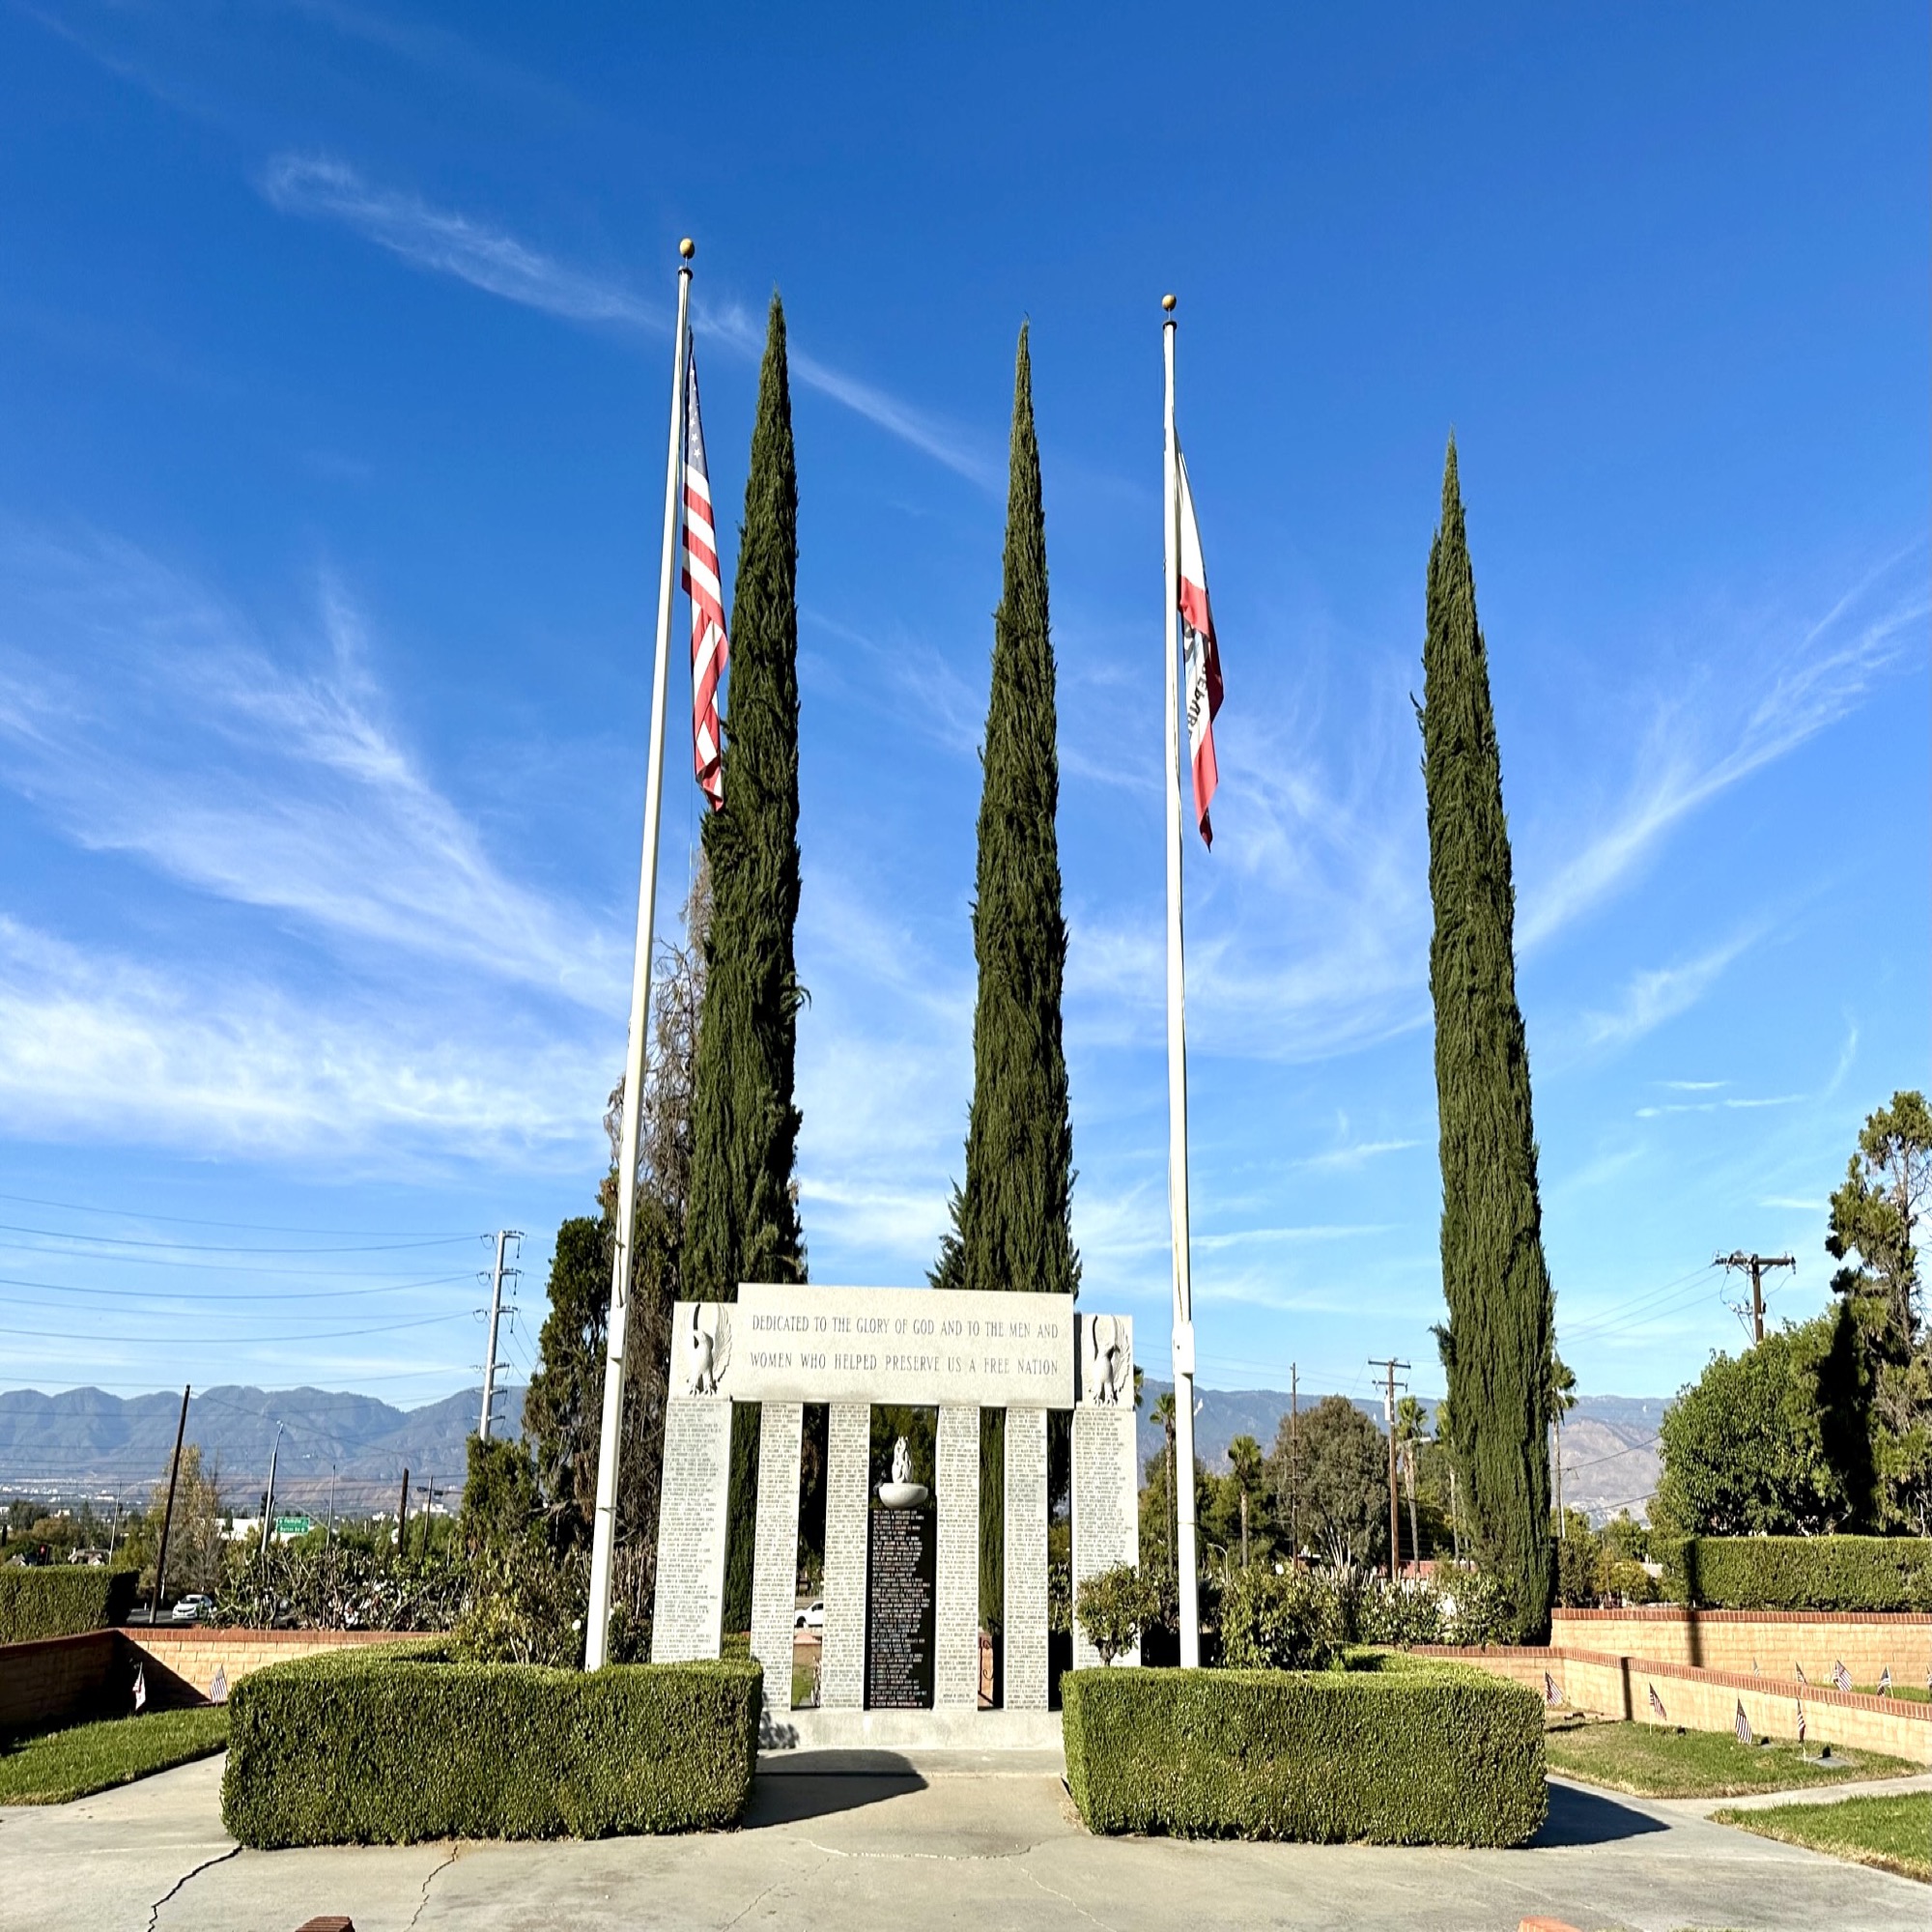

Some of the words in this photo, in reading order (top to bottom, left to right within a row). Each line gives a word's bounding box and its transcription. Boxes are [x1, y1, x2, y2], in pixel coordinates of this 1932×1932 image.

[753, 1315, 810, 1332] DEDICATED
[814, 1316, 827, 1332] TO
[833, 1317, 851, 1333] THE
[857, 1318, 890, 1334] GLORY
[895, 1319, 908, 1335] OF
[913, 1319, 934, 1335] GOD
[941, 1321, 962, 1336] AND
[967, 1321, 980, 1337] TO
[985, 1321, 1004, 1337] THE
[1009, 1321, 1031, 1338] MEN
[1037, 1323, 1059, 1339] AND
[751, 1351, 792, 1368] WOMEN
[801, 1352, 826, 1370] WHO
[835, 1353, 877, 1370] HELPED
[885, 1354, 940, 1372] PRESERVE
[948, 1356, 962, 1373] US
[969, 1358, 977, 1373] A
[984, 1357, 1009, 1375] FREE
[1017, 1359, 1058, 1376] NATION
